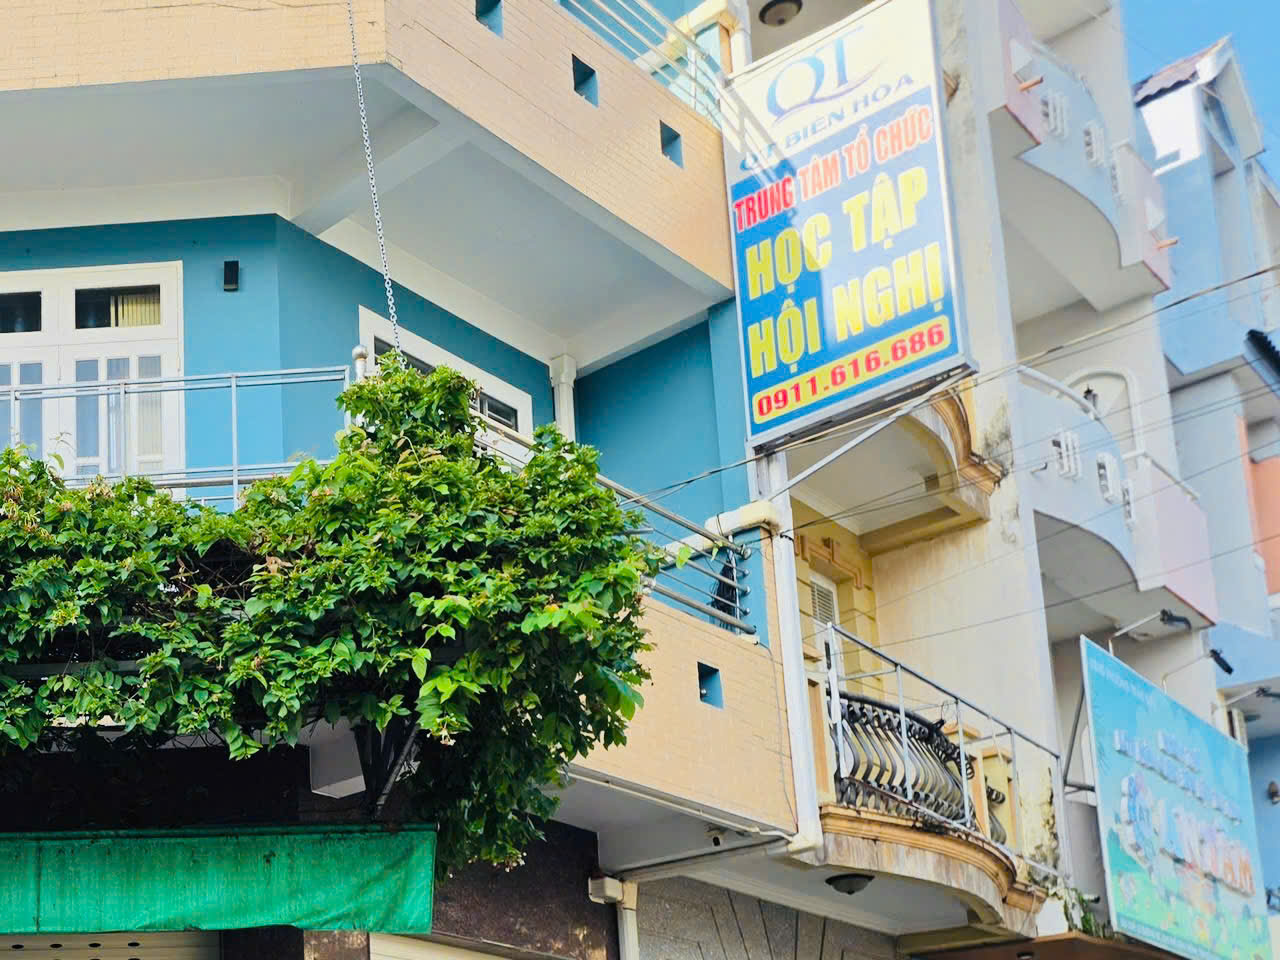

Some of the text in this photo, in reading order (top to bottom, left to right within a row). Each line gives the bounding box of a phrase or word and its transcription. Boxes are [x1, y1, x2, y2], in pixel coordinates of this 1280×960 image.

[733, 103, 933, 233] TRUNG TÂM TỔ CHỨC
[746, 167, 929, 300] HỌC TẬP
[747, 242, 946, 379] HỘI NGHỊ
[757, 323, 945, 418] 0911.616.686
